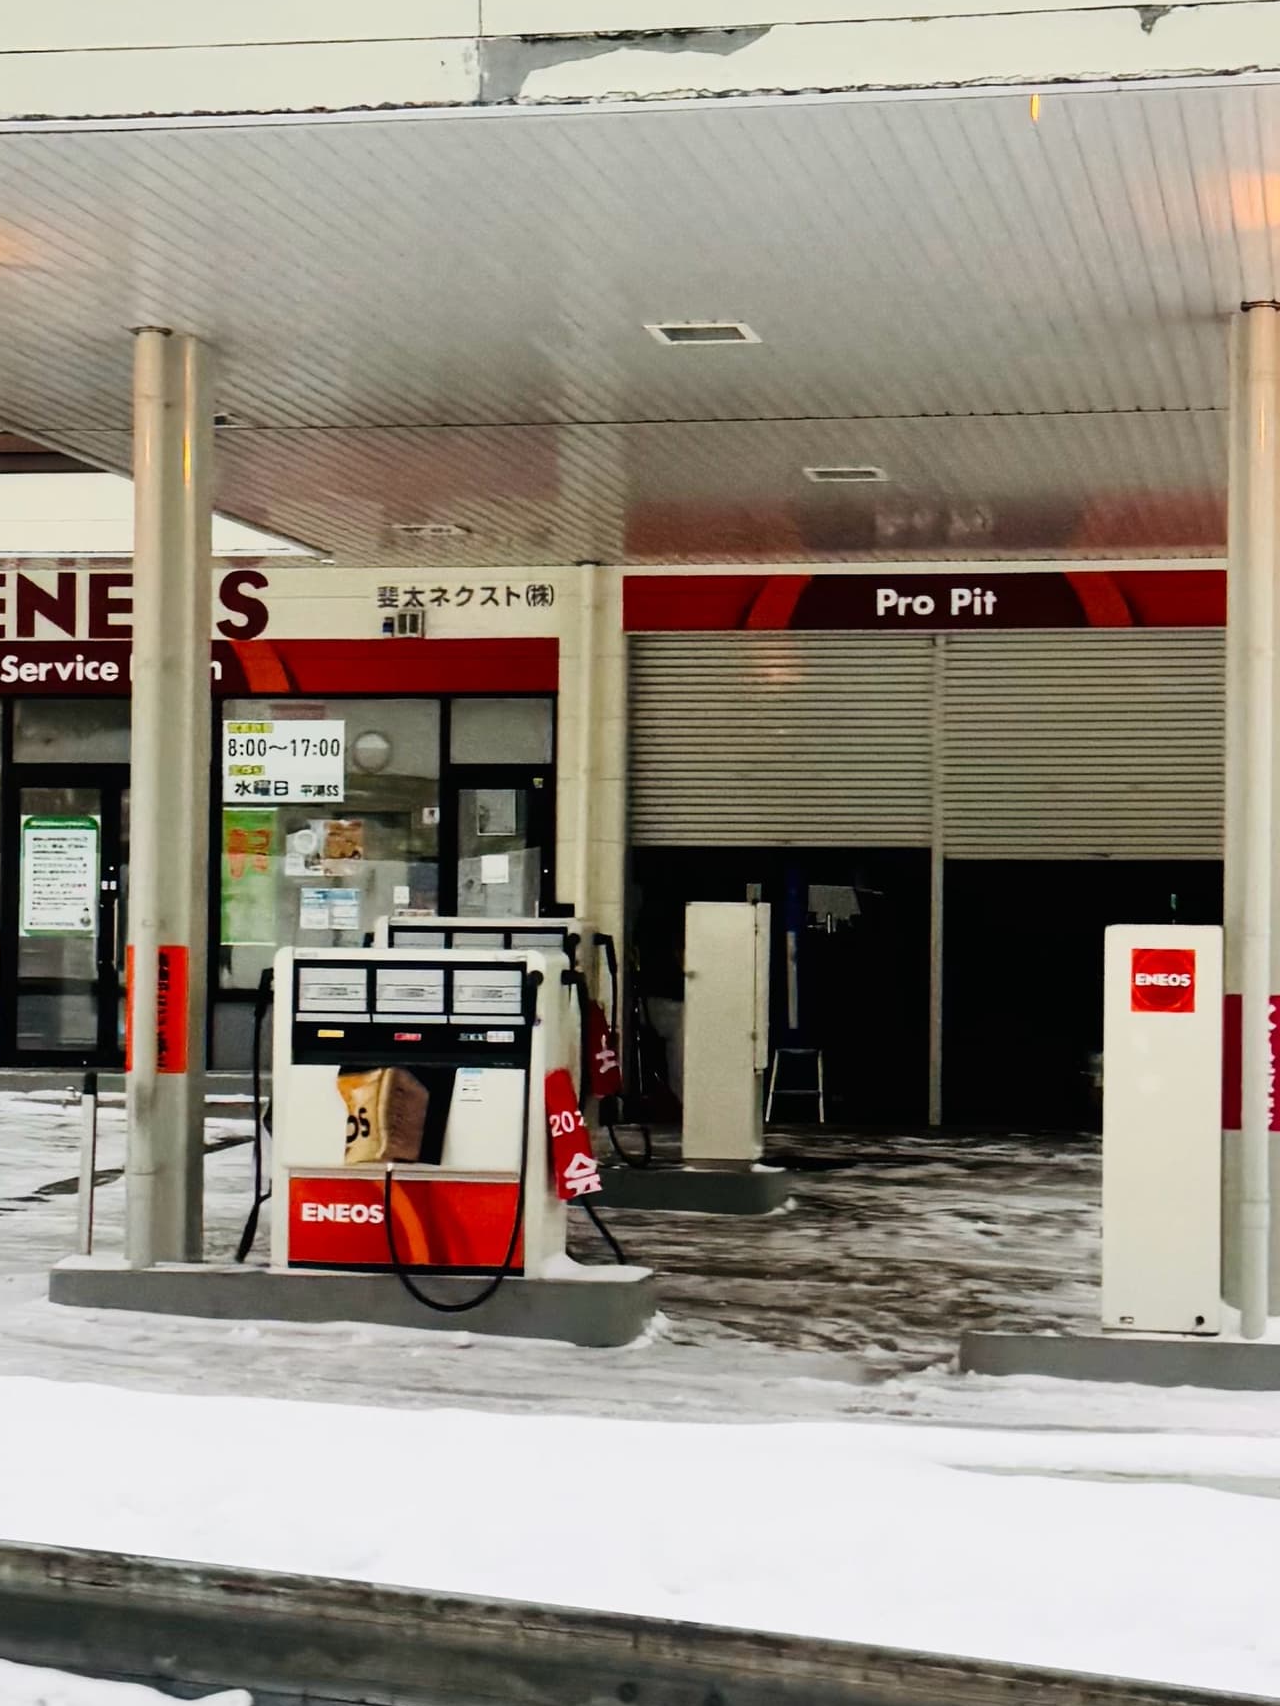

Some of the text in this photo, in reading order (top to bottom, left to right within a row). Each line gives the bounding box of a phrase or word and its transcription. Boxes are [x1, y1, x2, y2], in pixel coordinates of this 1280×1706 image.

[876, 587, 998, 617] Pro Pit
[0, 653, 120, 683] Service
[233, 779, 289, 797] 水曜日
[1135, 972, 1192, 988] ENEOS
[300, 1202, 385, 1225] ENEOS
